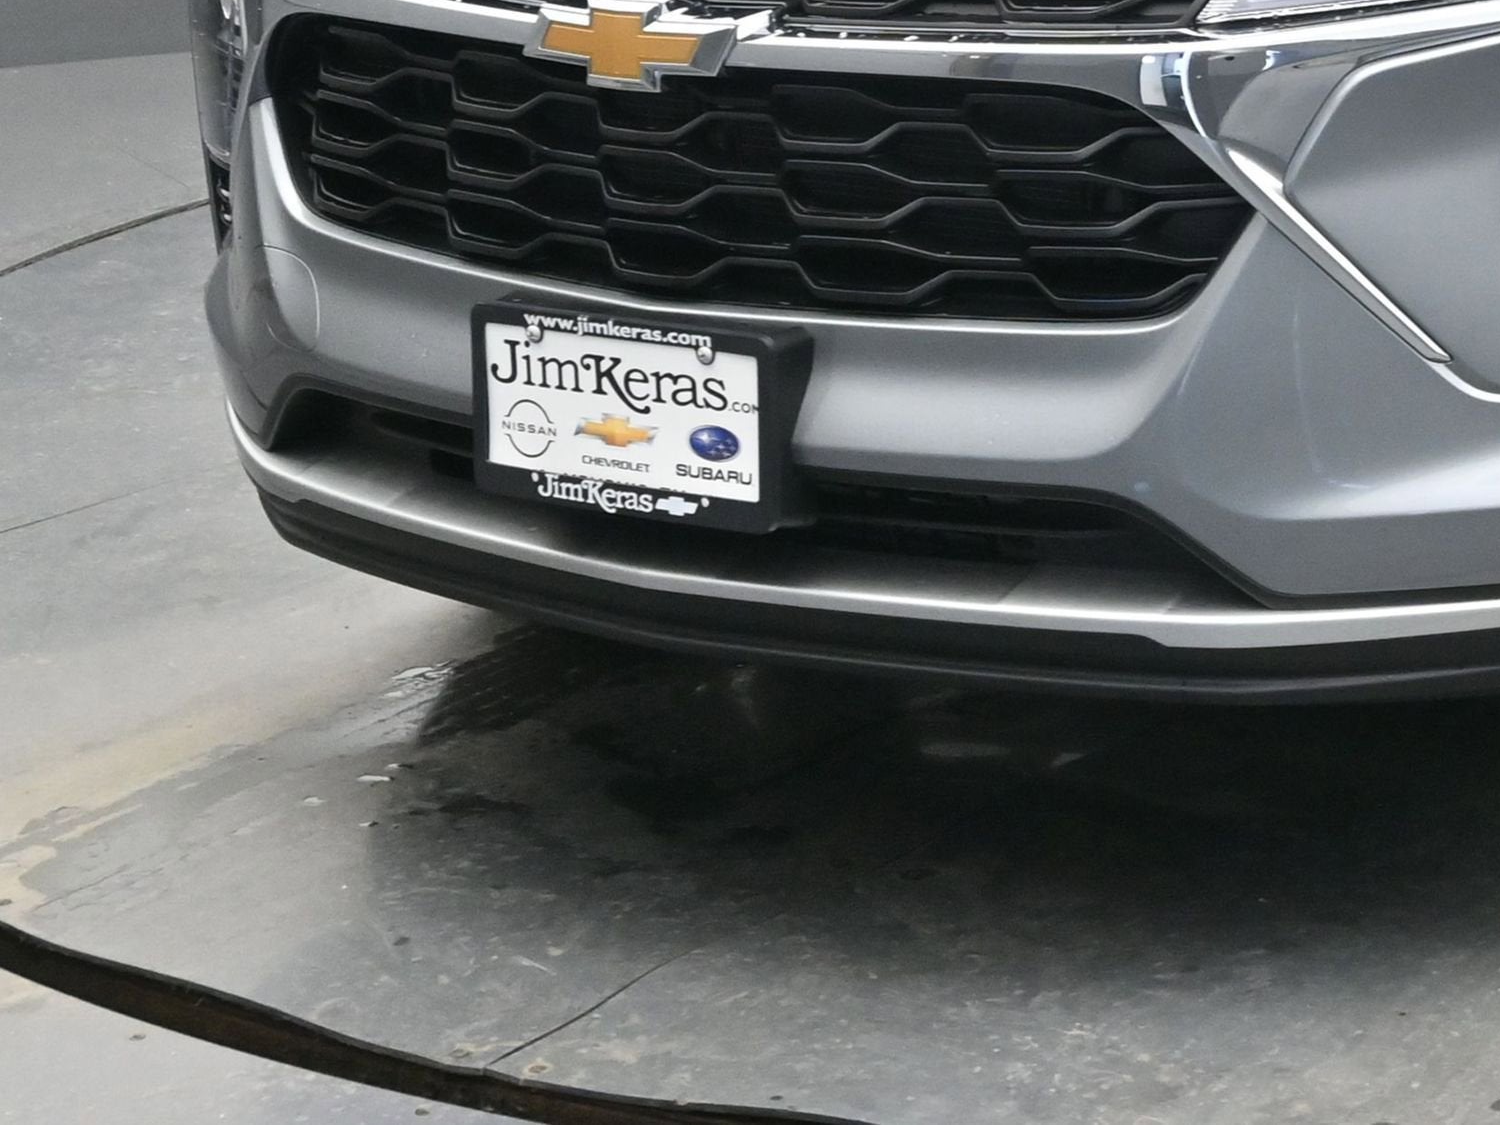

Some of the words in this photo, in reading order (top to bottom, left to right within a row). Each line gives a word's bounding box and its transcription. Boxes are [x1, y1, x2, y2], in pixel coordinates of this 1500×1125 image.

[523, 311, 711, 348] www.jimkeras.com
[501, 420, 557, 437] NISSAN
[581, 454, 651, 473] CHEVROLET
[675, 463, 752, 485] SUBARU
